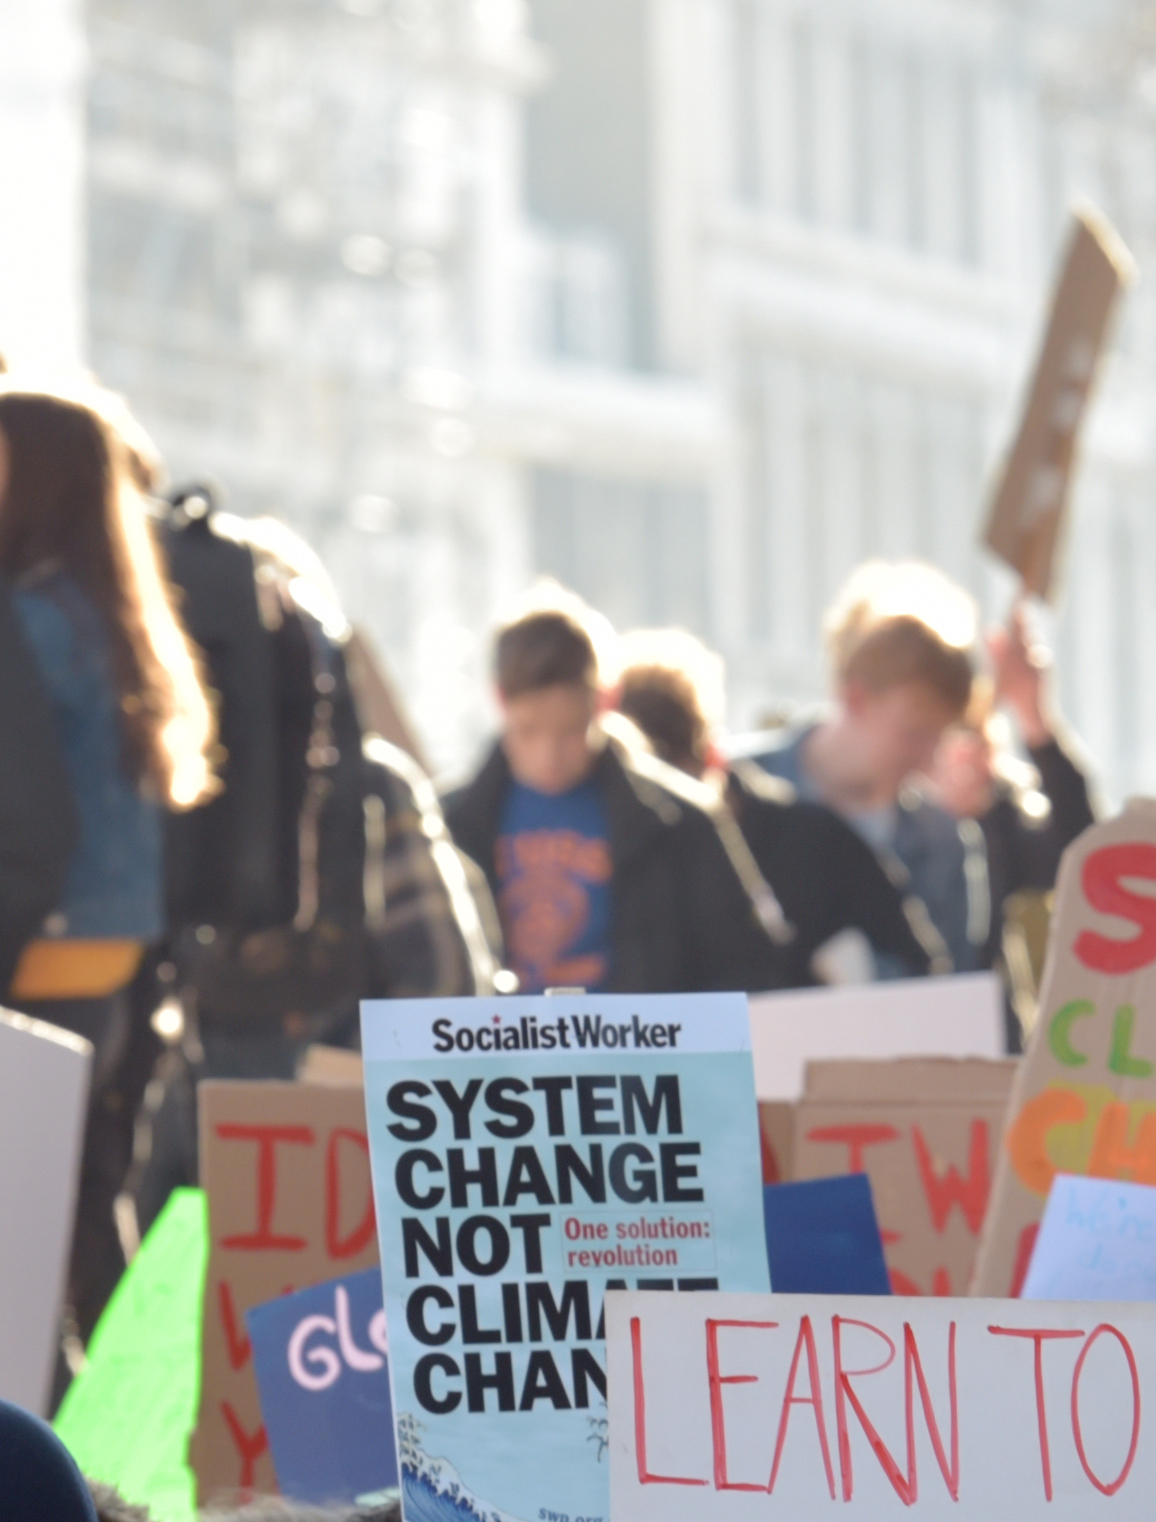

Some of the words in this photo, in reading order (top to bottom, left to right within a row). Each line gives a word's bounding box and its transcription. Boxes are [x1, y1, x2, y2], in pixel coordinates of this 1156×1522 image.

[386, 1074, 684, 1143] SYSTEM
[394, 1141, 705, 1210] CHANGE
[402, 1213, 552, 1279] NOT
[564, 1216, 608, 1242] One
[616, 1215, 712, 1241] solution:
[567, 1244, 679, 1269] revolution
[628, 1314, 961, 1506] LEARN
[986, 1322, 1141, 1503] TO
